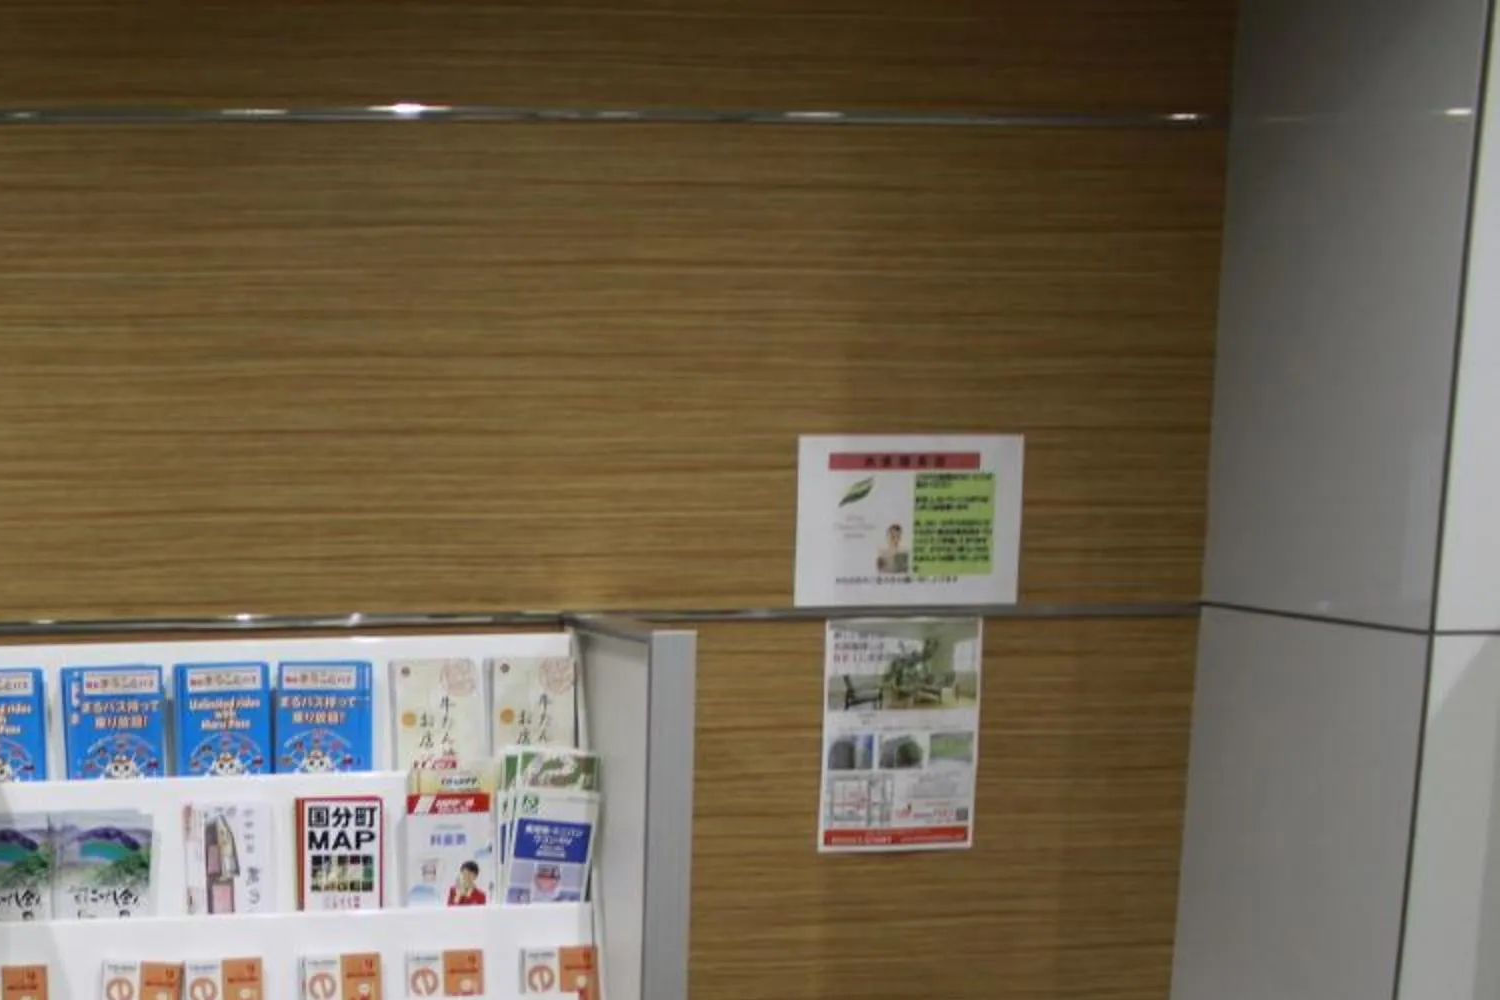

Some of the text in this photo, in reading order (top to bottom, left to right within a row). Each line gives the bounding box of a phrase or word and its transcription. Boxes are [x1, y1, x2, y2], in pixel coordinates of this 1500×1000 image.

[307, 805, 377, 828] 国分町
[307, 831, 376, 851] MAP
